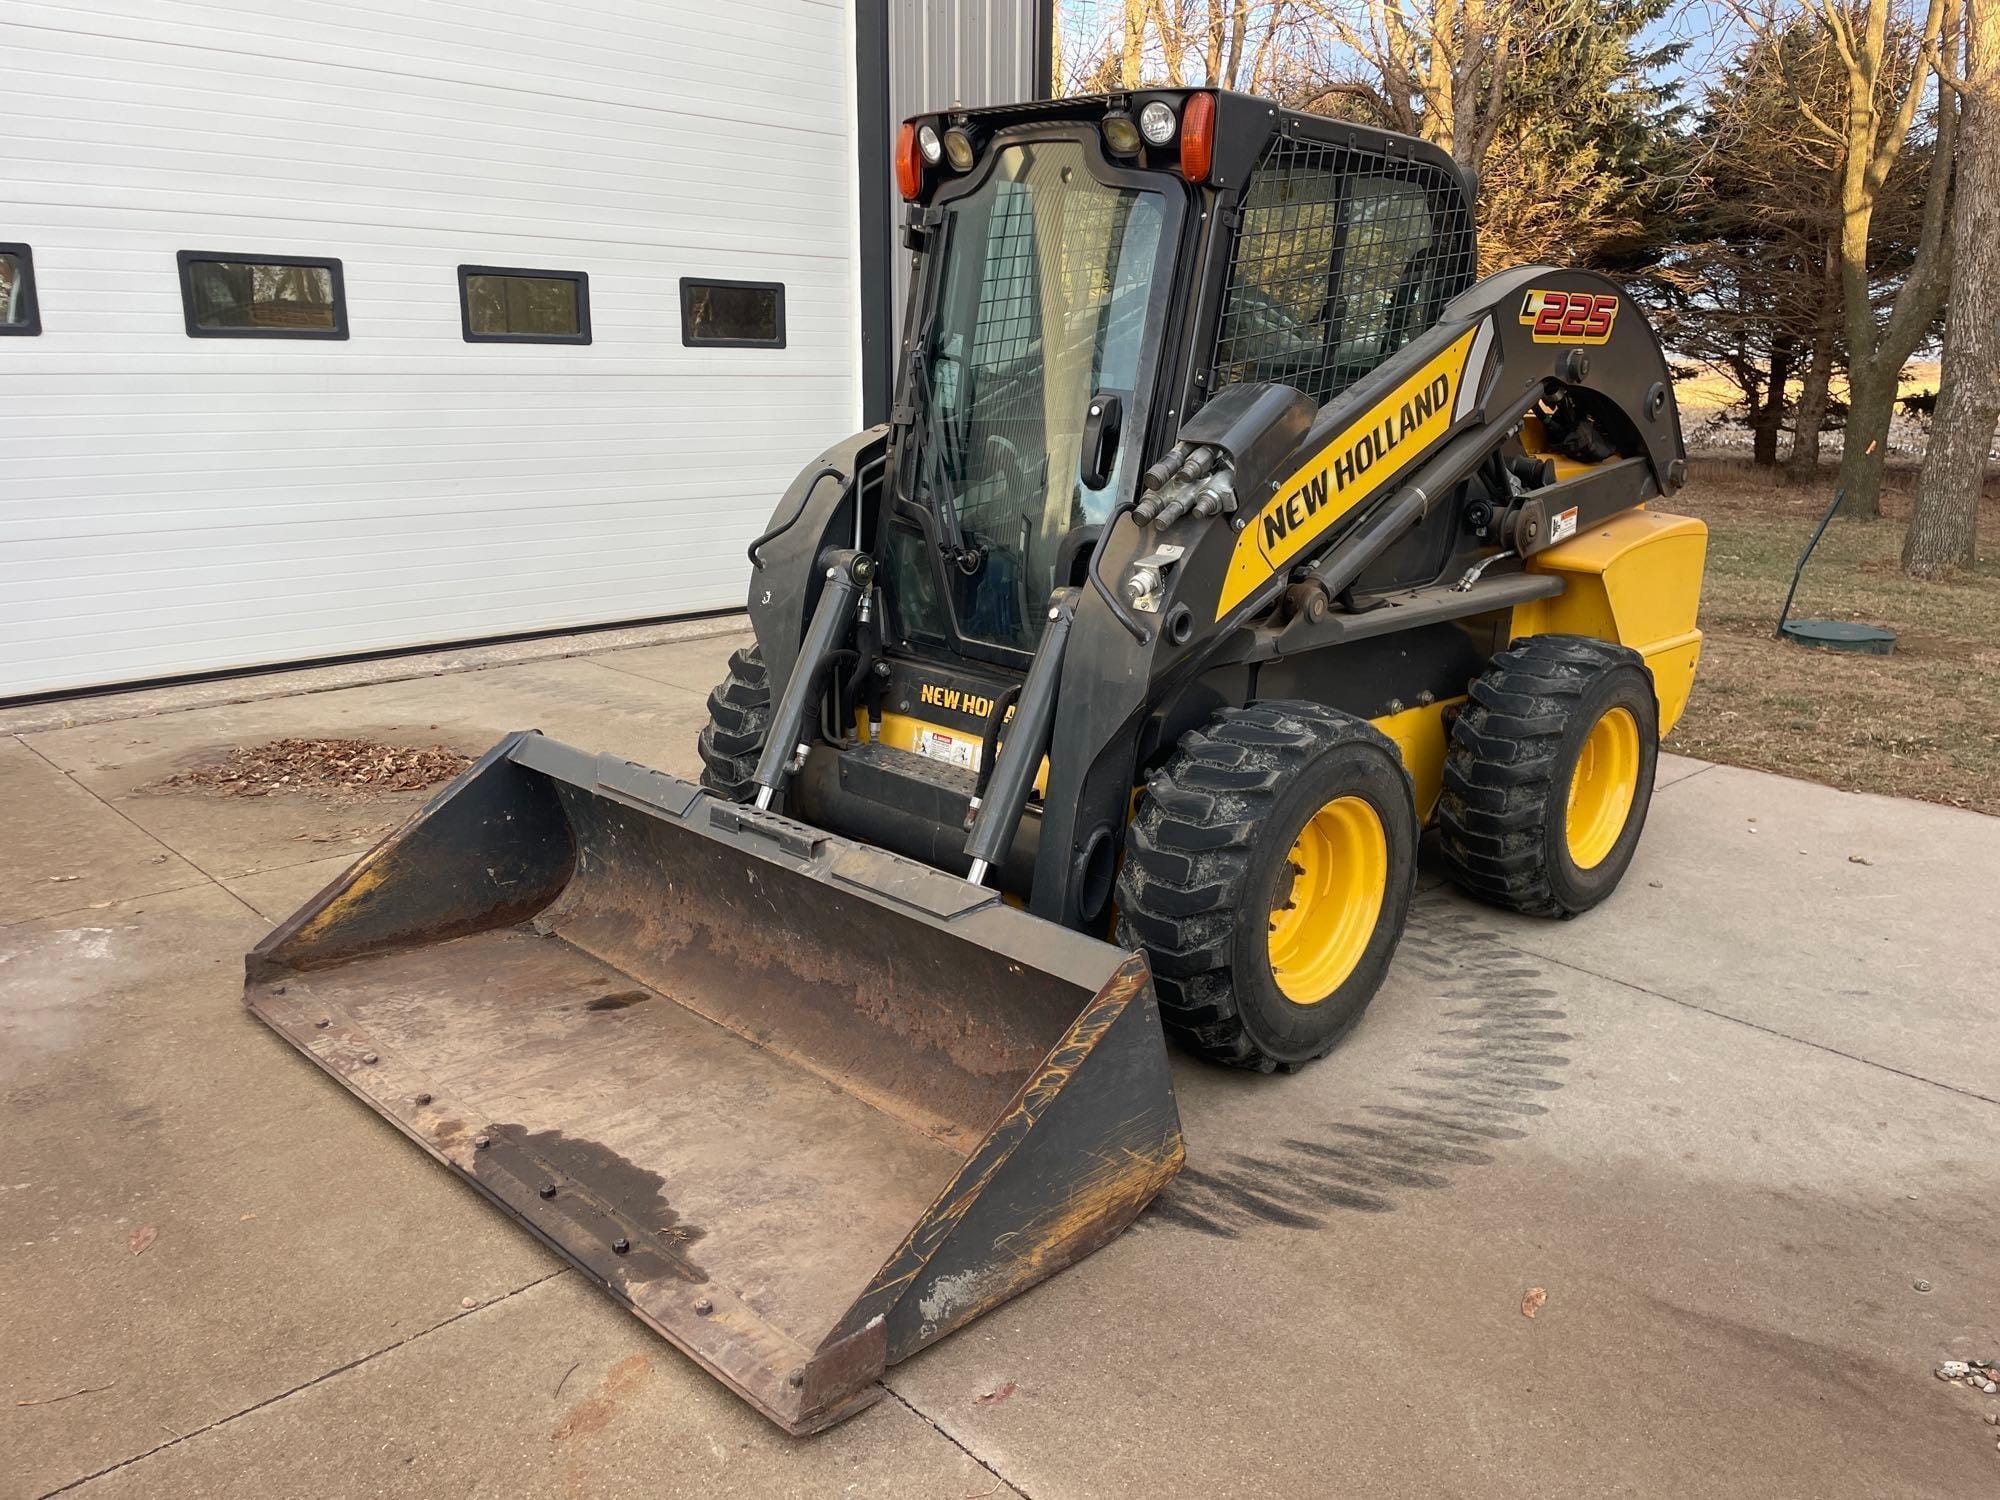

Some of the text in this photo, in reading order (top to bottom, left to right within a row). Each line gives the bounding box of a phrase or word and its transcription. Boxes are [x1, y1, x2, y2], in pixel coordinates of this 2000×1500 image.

[1520, 292, 1617, 338] L225
[1263, 373, 1450, 550] NEW HOLLAND
[921, 684, 960, 710] NEW
